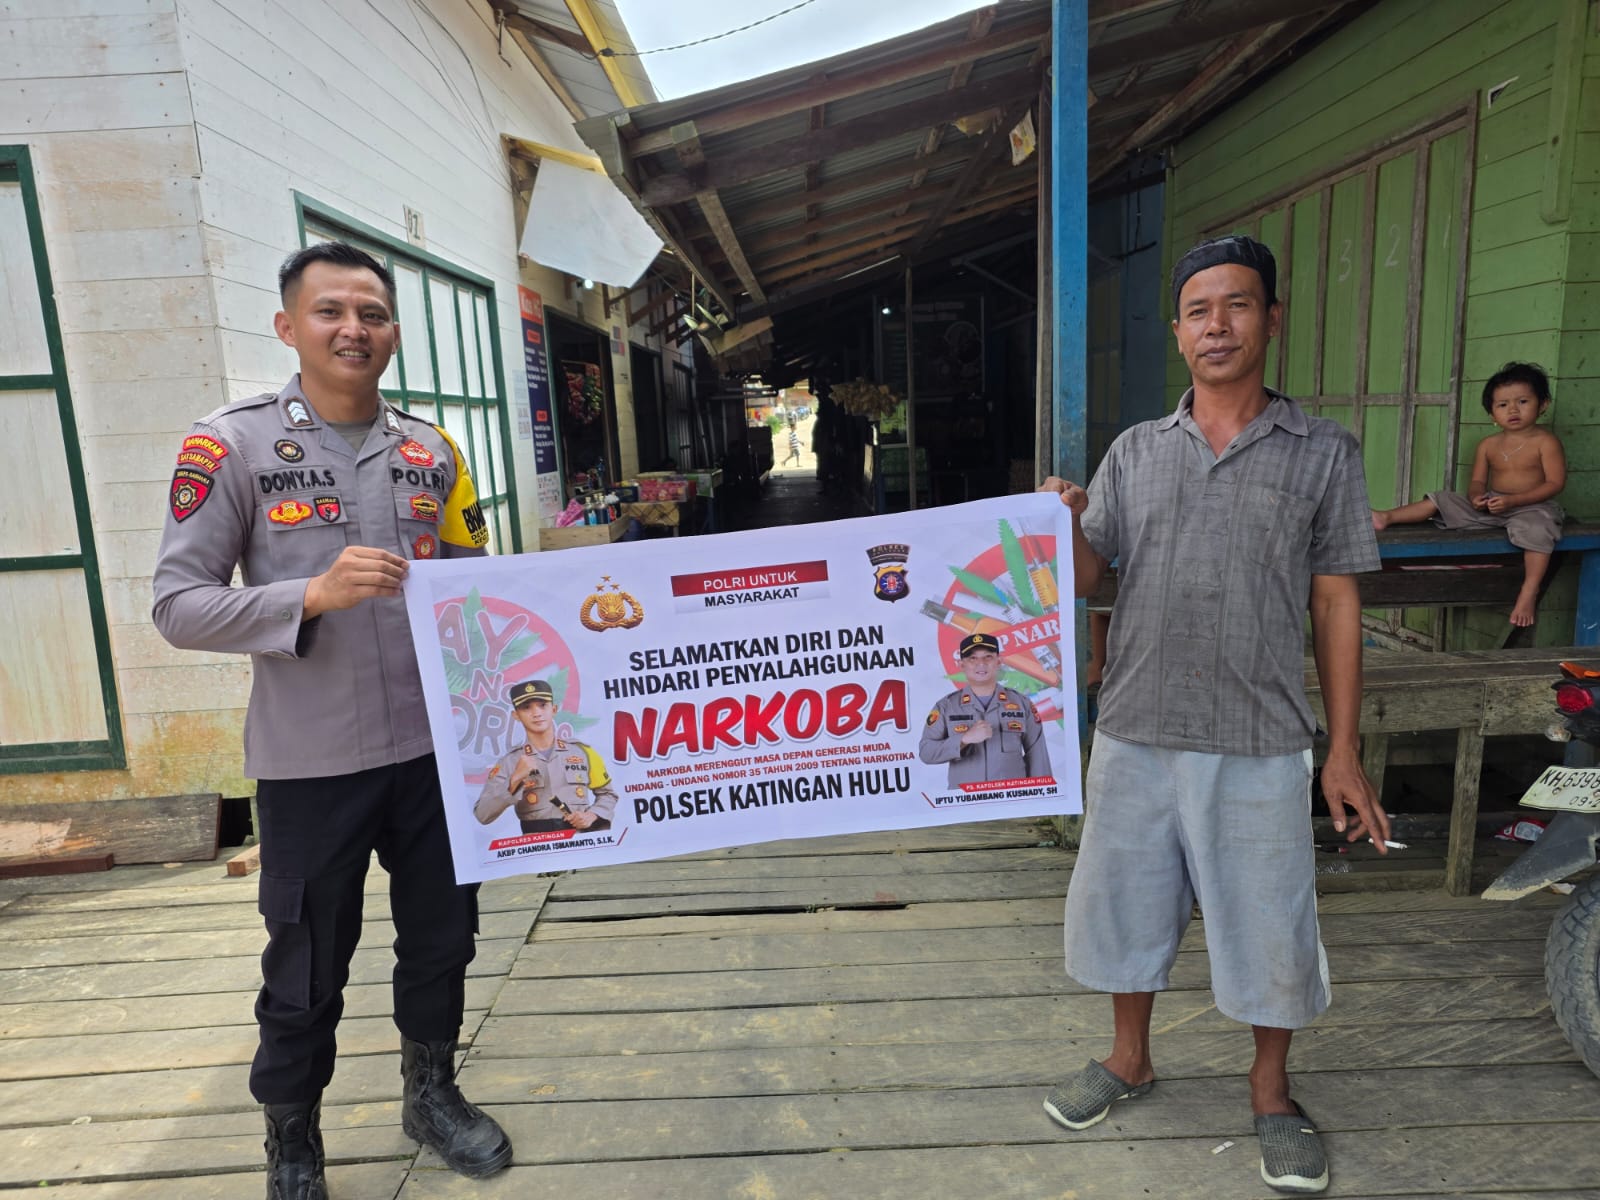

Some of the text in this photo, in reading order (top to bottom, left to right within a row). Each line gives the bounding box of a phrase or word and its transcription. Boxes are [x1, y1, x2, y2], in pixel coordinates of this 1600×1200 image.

[1338, 239, 1353, 283] 3
[1384, 223, 1401, 268] 2
[258, 469, 336, 494] DONY.A.S
[391, 467, 445, 491] POLRI
[703, 571, 798, 592] POLRI UNTUK
[704, 587, 800, 608] MASYARAKAT
[629, 625, 884, 671] SELAMATKAN DIRI DAN
[603, 647, 915, 700] HINDARI PENYALAHGUNAAN
[613, 679, 910, 763] NARKOBA
[624, 781, 664, 793] UNDANG
[671, 776, 710, 787] UNDANG
[712, 770, 748, 782] NOMOR
[749, 768, 761, 777] 35
[763, 764, 793, 775] TAHUN
[795, 761, 819, 772] 2009
[821, 757, 861, 770] TENTANG
[863, 752, 915, 765] NARKOTIKA
[646, 742, 891, 779] NARKOBA MERENGGUT MASA DEPAN GENERASI MUDA
[634, 767, 911, 824] POLSEK KATINGAN HULU
[935, 786, 1058, 805] IPTU YUBAMBANG KUSNADY, SH
[497, 849, 516, 859] AKBP
[517, 844, 551, 856] CHANDRA
[552, 839, 596, 850] ISMAWANTO,
